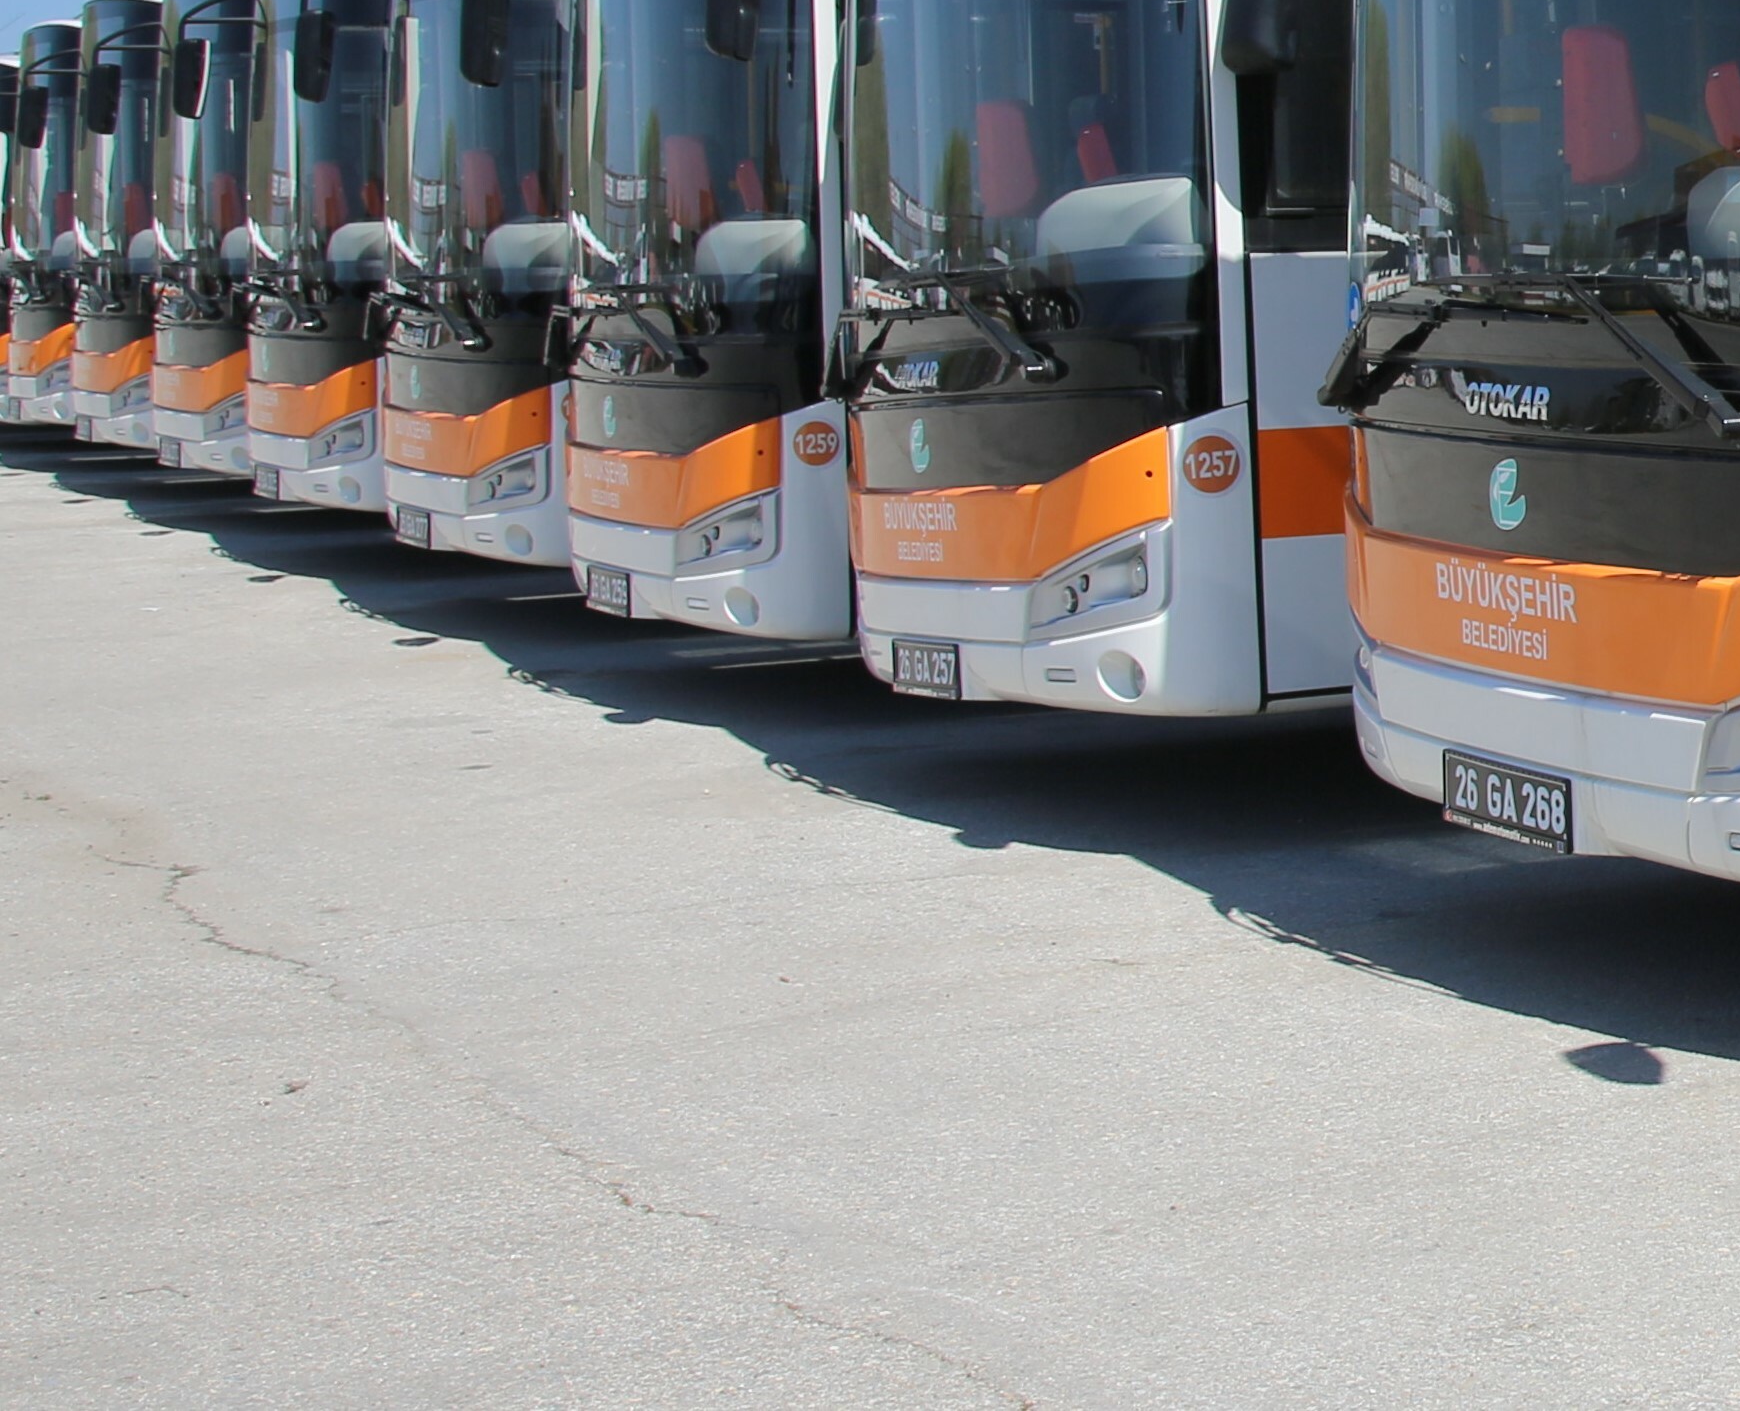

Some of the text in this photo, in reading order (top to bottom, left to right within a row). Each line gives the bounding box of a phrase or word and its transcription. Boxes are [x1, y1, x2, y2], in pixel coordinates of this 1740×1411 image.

[1465, 381, 1550, 421] OTOKAR
[795, 433, 838, 455] 1259
[1184, 450, 1239, 480] 1257
[1435, 559, 1578, 623] BÜYÜKŞEHİR
[1461, 619, 1548, 661] BELEDİYESİ
[898, 648, 956, 685] 26 GA 257
[1455, 764, 1566, 835] 26 GA 268
